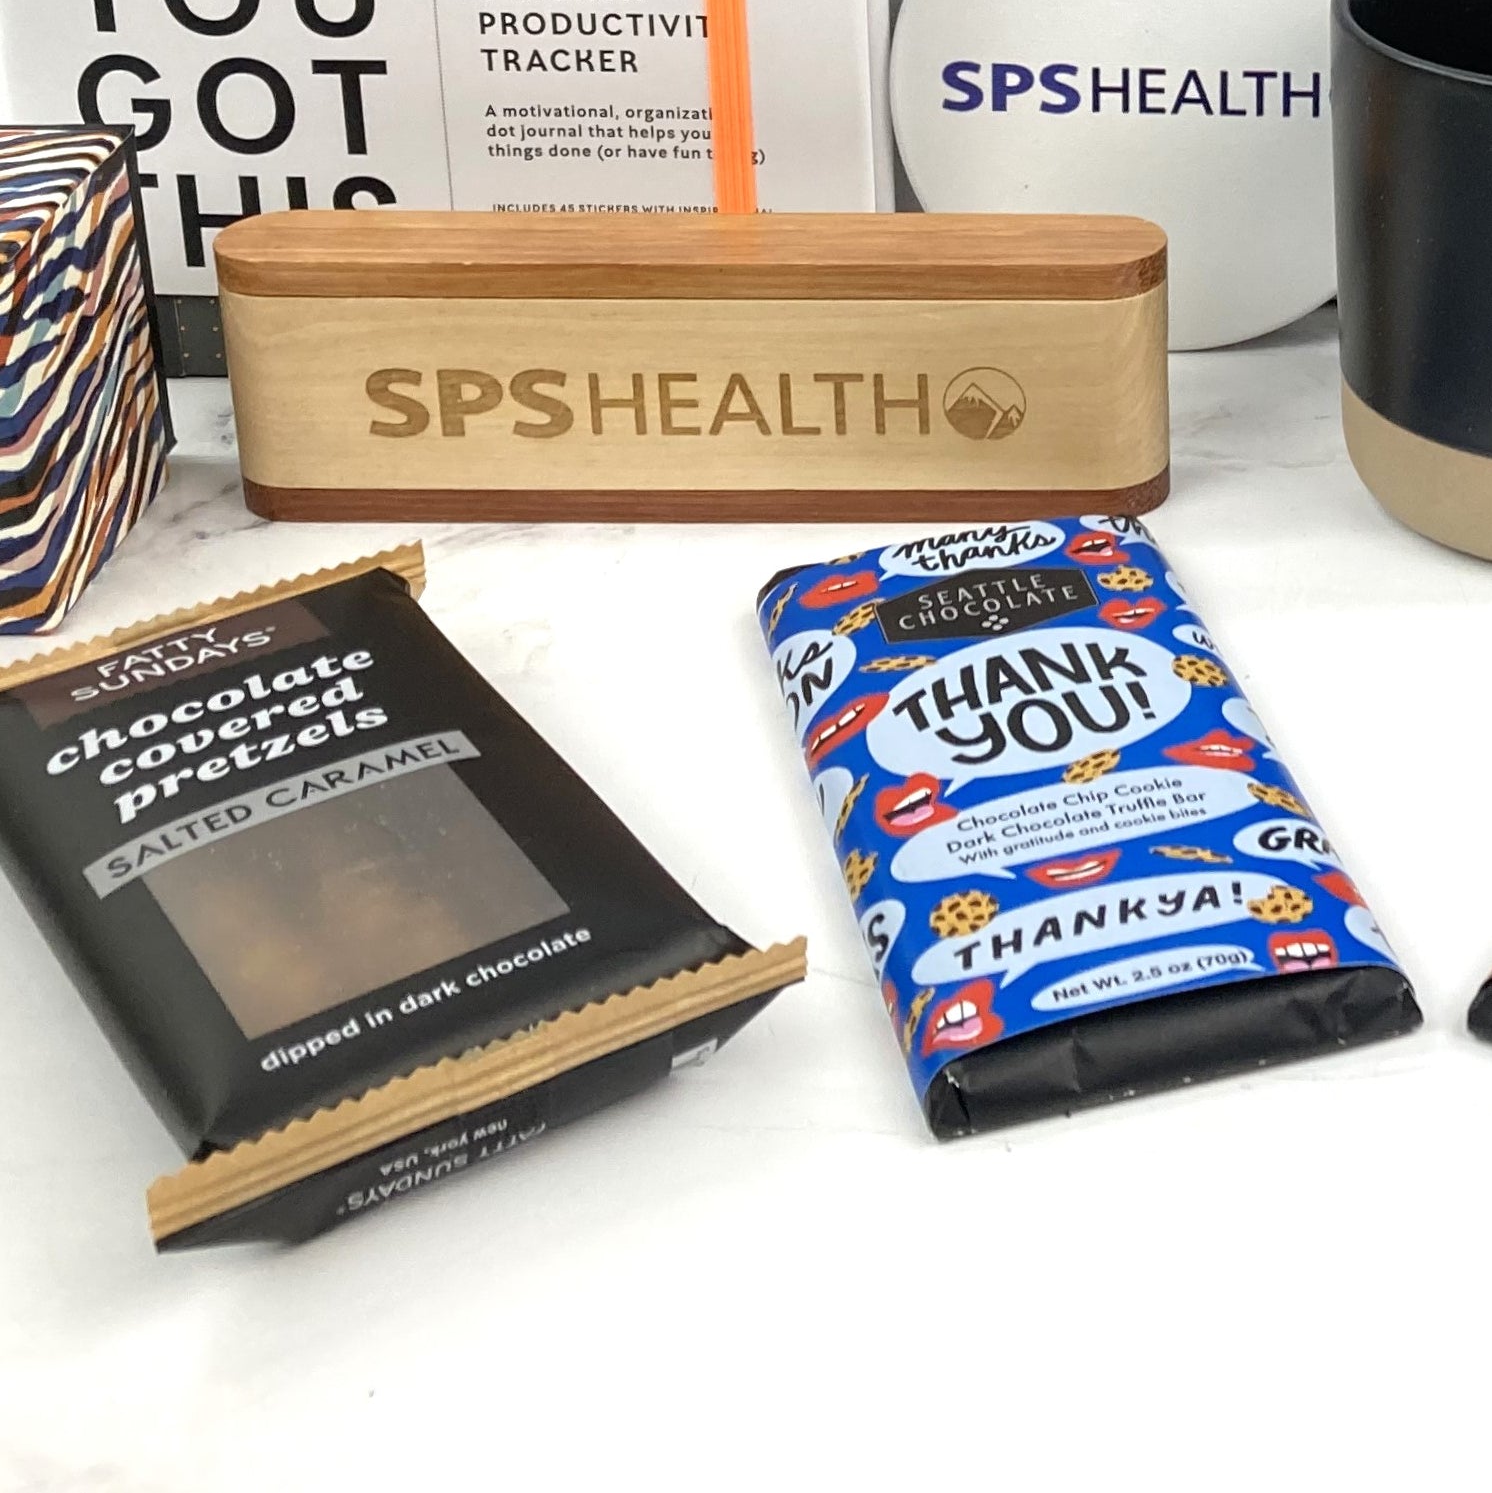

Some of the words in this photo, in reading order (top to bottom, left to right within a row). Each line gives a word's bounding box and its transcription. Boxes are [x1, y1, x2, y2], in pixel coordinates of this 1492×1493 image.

[479, 12, 708, 38] PRODUCTIVIT
[480, 49, 638, 73] TRACKER
[77, 54, 388, 155] GOT
[485, 105, 497, 117] A
[503, 105, 620, 120] motivational,
[625, 106, 713, 123] organizati
[487, 125, 515, 138] dot
[521, 124, 582, 141] journal
[588, 125, 623, 138] that
[629, 125, 675, 142] helps
[681, 130, 711, 142] you
[488, 145, 542, 161] things
[549, 145, 591, 157] done
[597, 145, 621, 161] (or
[627, 146, 667, 159] have
[673, 146, 700, 159] fun
[892, 524, 1031, 560] many
[914, 533, 1057, 573] thanks
[898, 585, 1078, 631] CHOCOLATE
[917, 574, 1047, 610] SEATTLE
[97, 627, 217, 677] FATTY
[46, 649, 374, 776] chocolate
[892, 642, 1147, 732] THANK
[99, 676, 363, 786] covered
[934, 681, 1156, 765] YOU!
[113, 706, 388, 825] pretzels
[107, 805, 252, 879] SALTED
[265, 740, 460, 808] CARAMEL
[946, 830, 996, 854] Dark
[1001, 809, 1101, 838] Chocolate
[1105, 795, 1167, 816] Truffle
[1173, 791, 1207, 804] Bar
[956, 800, 1057, 833] Chocolate
[1063, 789, 1108, 807] Chip
[1114, 777, 1182, 796] Cookie
[958, 846, 998, 865] With
[1003, 828, 1074, 855] gratitude
[1078, 822, 1110, 836] and
[1113, 813, 1166, 829] cookie
[1171, 806, 1207, 820] bites
[952, 880, 1244, 971] THANKYA!
[260, 1019, 361, 1072] dipped
[364, 1007, 393, 1028] in
[399, 980, 461, 1015] dark
[465, 927, 592, 988] chocolate
[1052, 986, 1089, 1003] Net
[1092, 976, 1128, 991] Wt.
[1132, 968, 1163, 983] 2.5
[1168, 962, 1193, 974] oz
[1196, 949, 1248, 972] (70g)
[379, 1153, 419, 1177] USA
